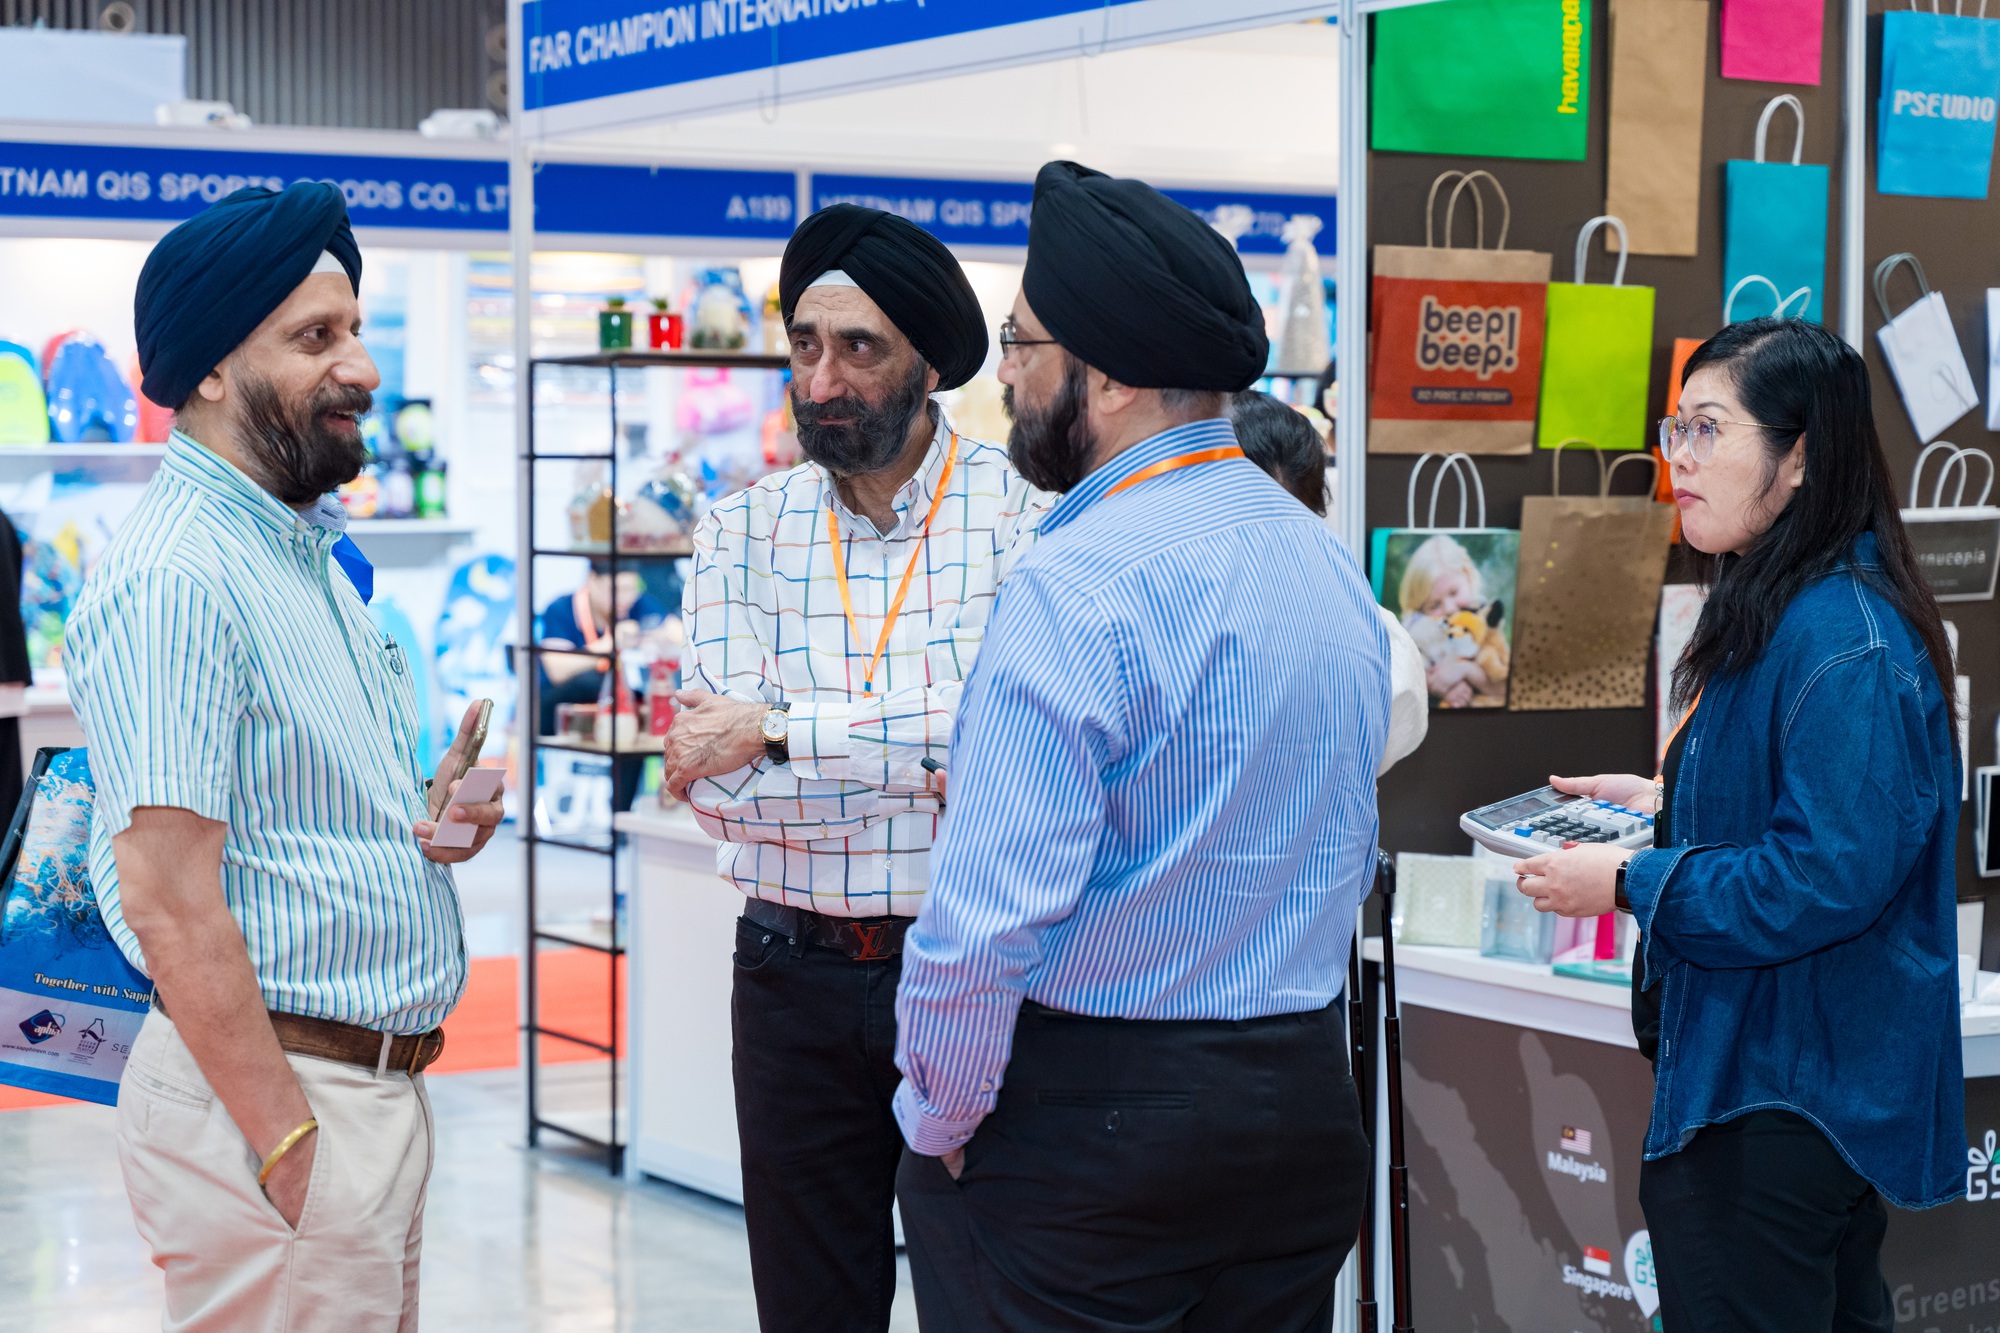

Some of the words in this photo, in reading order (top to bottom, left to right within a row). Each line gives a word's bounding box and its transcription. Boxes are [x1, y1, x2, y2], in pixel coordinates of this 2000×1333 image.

[529, 30, 572, 74] FAR
[575, 3, 696, 66] CHAMPION
[1893, 89, 1996, 122] PSEUDIO
[97, 170, 151, 201] QIS
[34, 972, 89, 992] Together
[92, 984, 119, 998] with
[1547, 1151, 1608, 1183] Malaysia
[1562, 1264, 1633, 1301] Singapore
[1893, 1278, 2000, 1324] Greens
